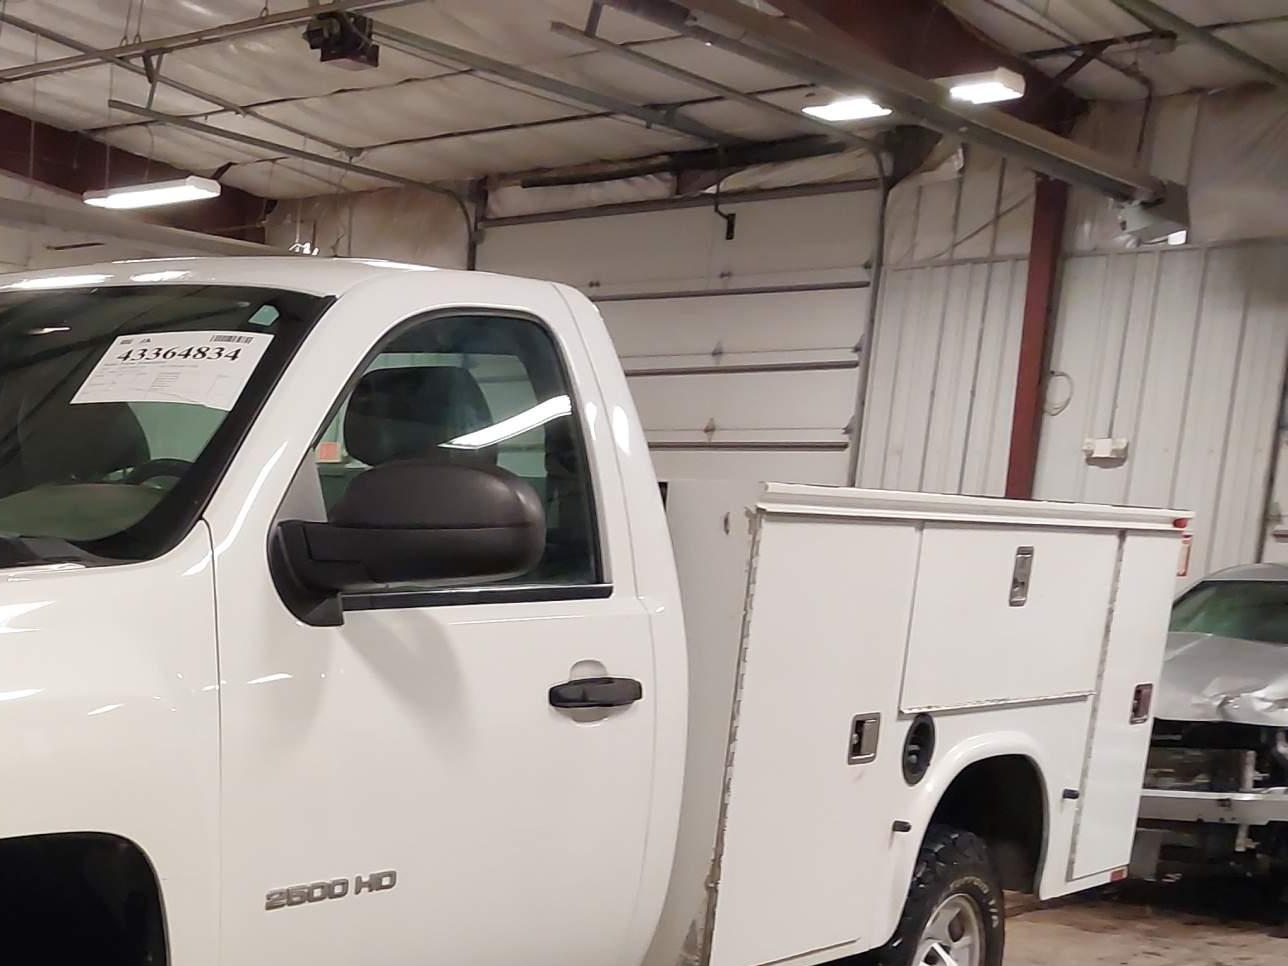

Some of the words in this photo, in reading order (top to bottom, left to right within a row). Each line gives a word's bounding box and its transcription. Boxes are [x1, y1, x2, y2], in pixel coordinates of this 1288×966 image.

[117, 346, 241, 361] 43364834
[265, 878, 349, 911] 2500
[355, 870, 397, 895] HD
